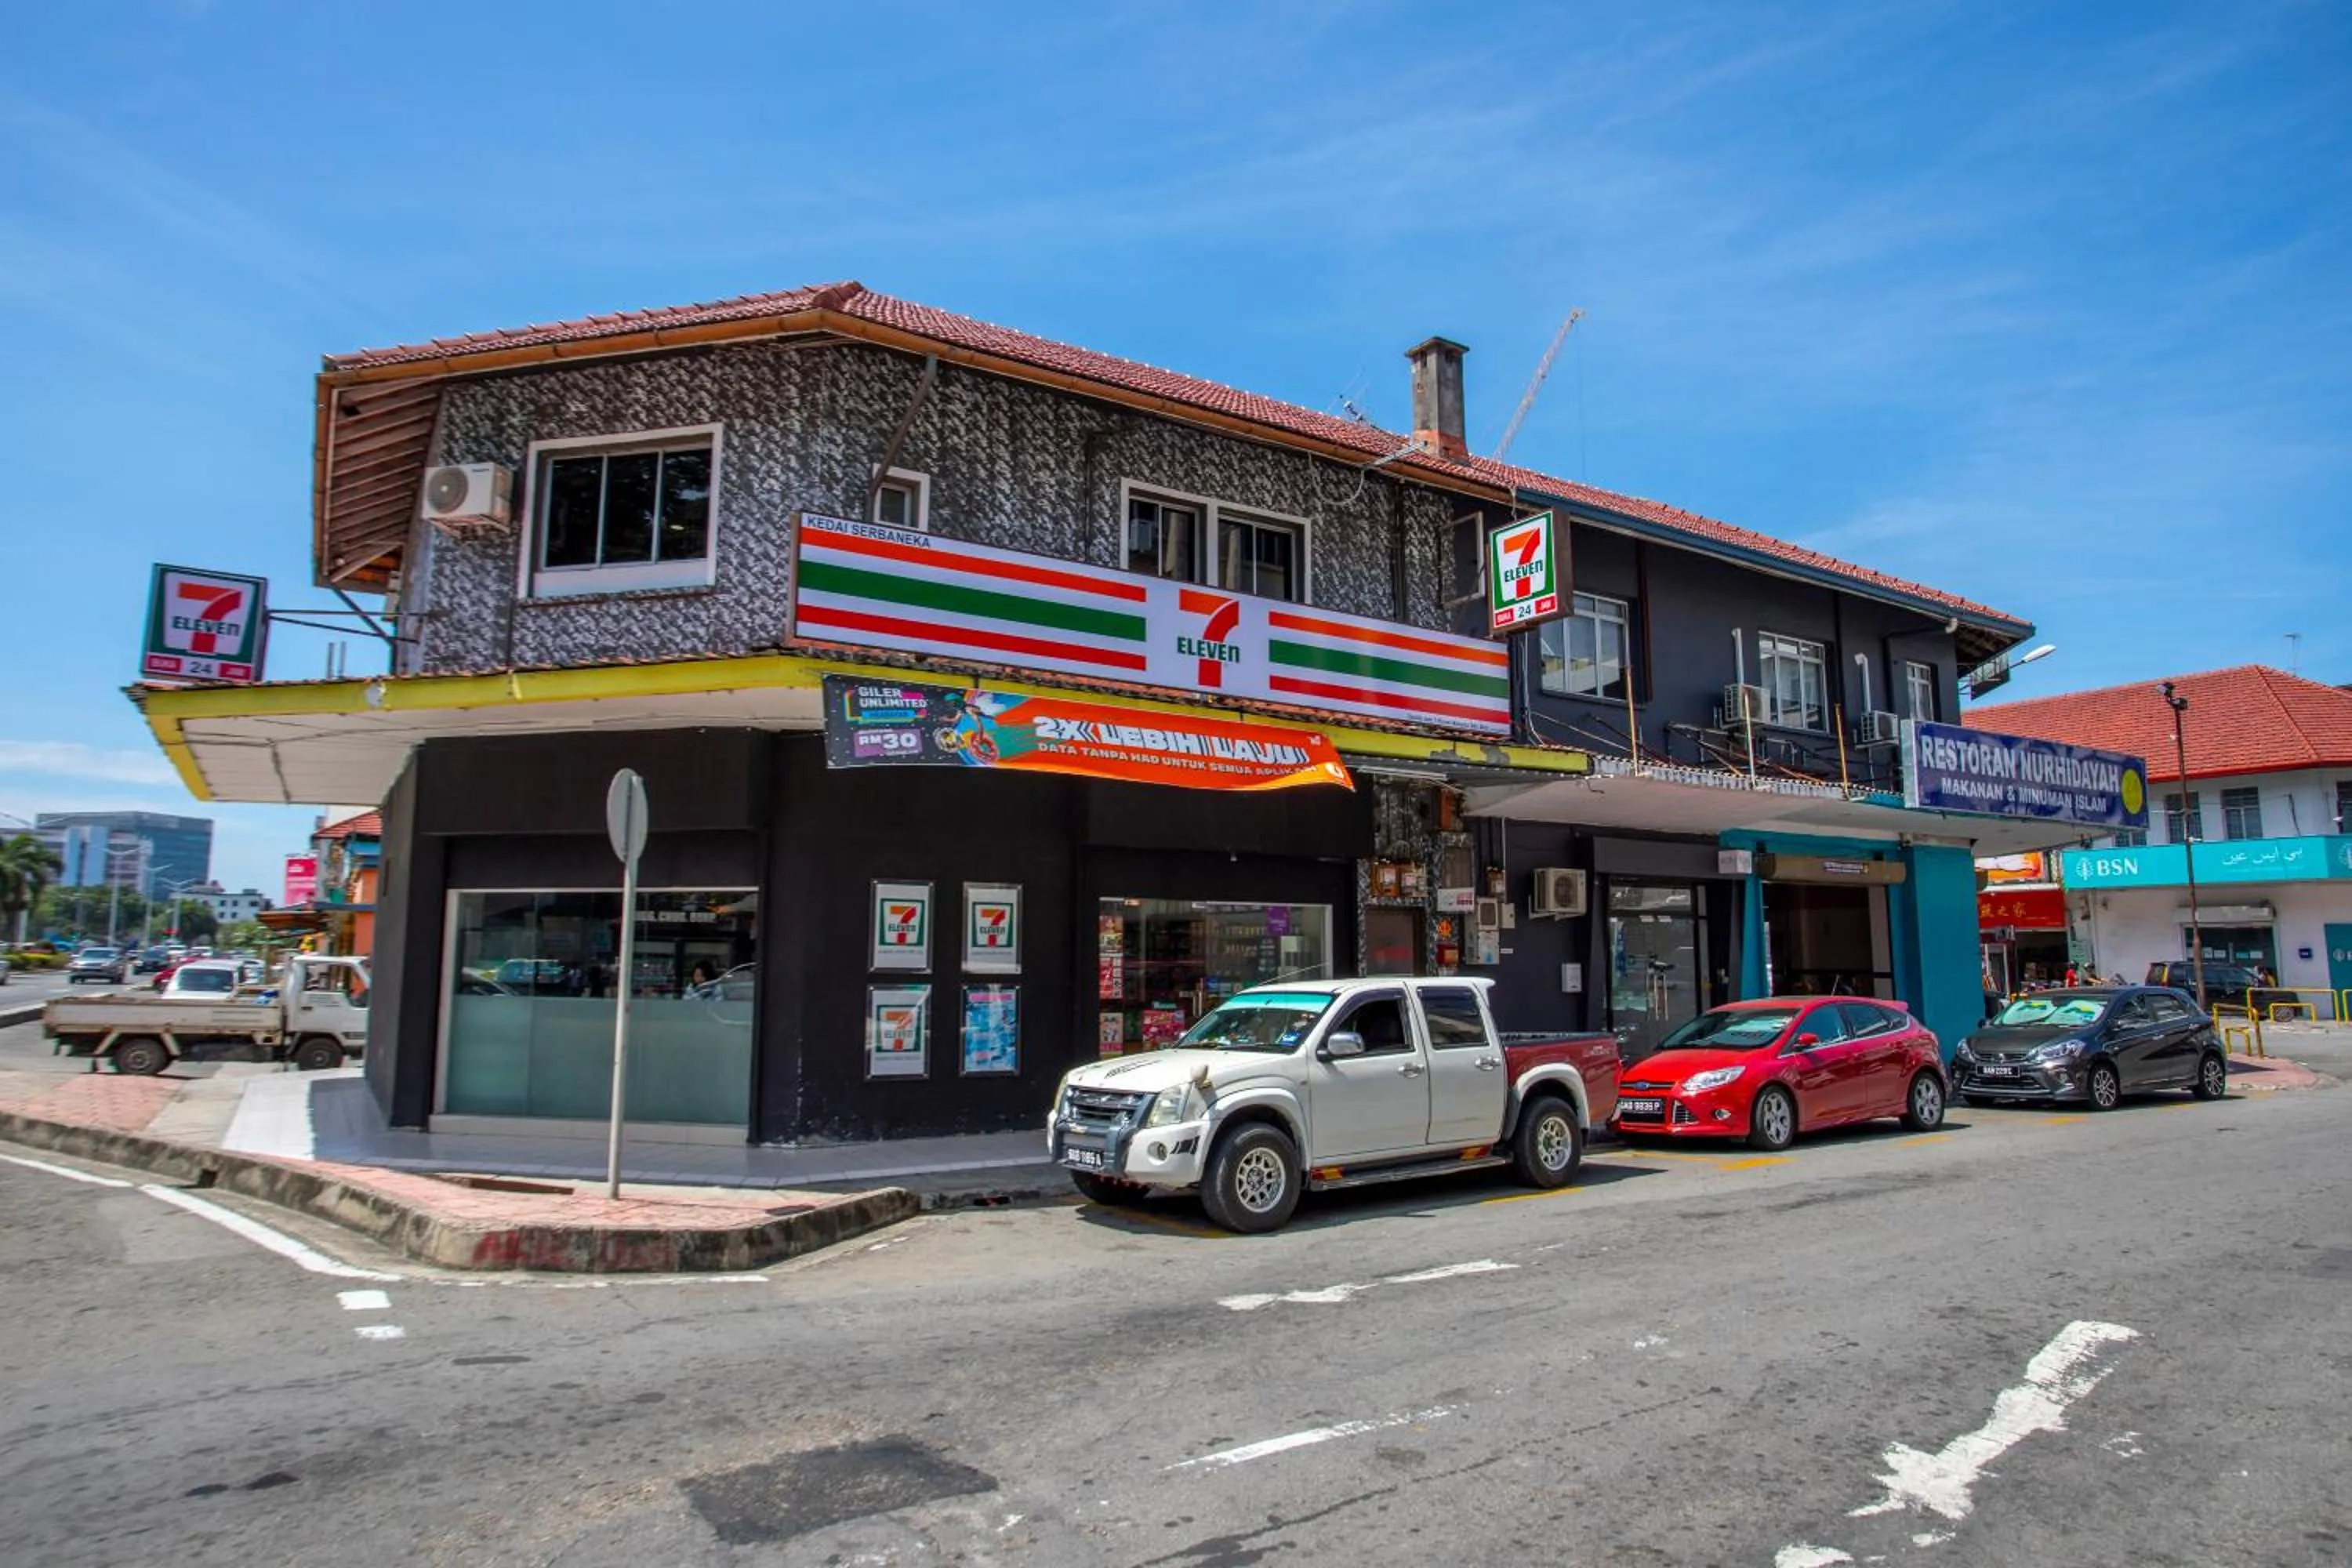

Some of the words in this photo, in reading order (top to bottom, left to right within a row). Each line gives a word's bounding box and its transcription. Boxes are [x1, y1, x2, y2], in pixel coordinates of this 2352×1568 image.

[807, 515, 848, 533] KEDAI
[851, 524, 931, 548] SERBANEKA
[1503, 527, 1541, 599] 7
[177, 582, 241, 653] 7
[1518, 604, 1531, 618] 24
[1178, 589, 1240, 688] 7
[189, 661, 213, 674] 24
[858, 687, 902, 697] GILER
[859, 698, 927, 708] UNLIMITED
[1038, 742, 1077, 755] DATA
[1080, 747, 1128, 760] TANPA
[1131, 753, 1160, 764] HAD
[1162, 758, 1206, 771] UNTUK
[1210, 762, 1253, 775] SEMUA
[1921, 735, 2016, 779] RESTORAN
[2020, 750, 2120, 793] NURHIDAYAH
[1941, 777, 2003, 801] MAKANAN
[2007, 787, 2016, 801] &
[2019, 787, 2072, 809] MINUMAN
[2075, 795, 2107, 812] ISLAM
[2097, 859, 2138, 877] BSN
[891, 905, 916, 946] 7
[982, 909, 1006, 947] 7
[884, 1011, 914, 1052] 7
